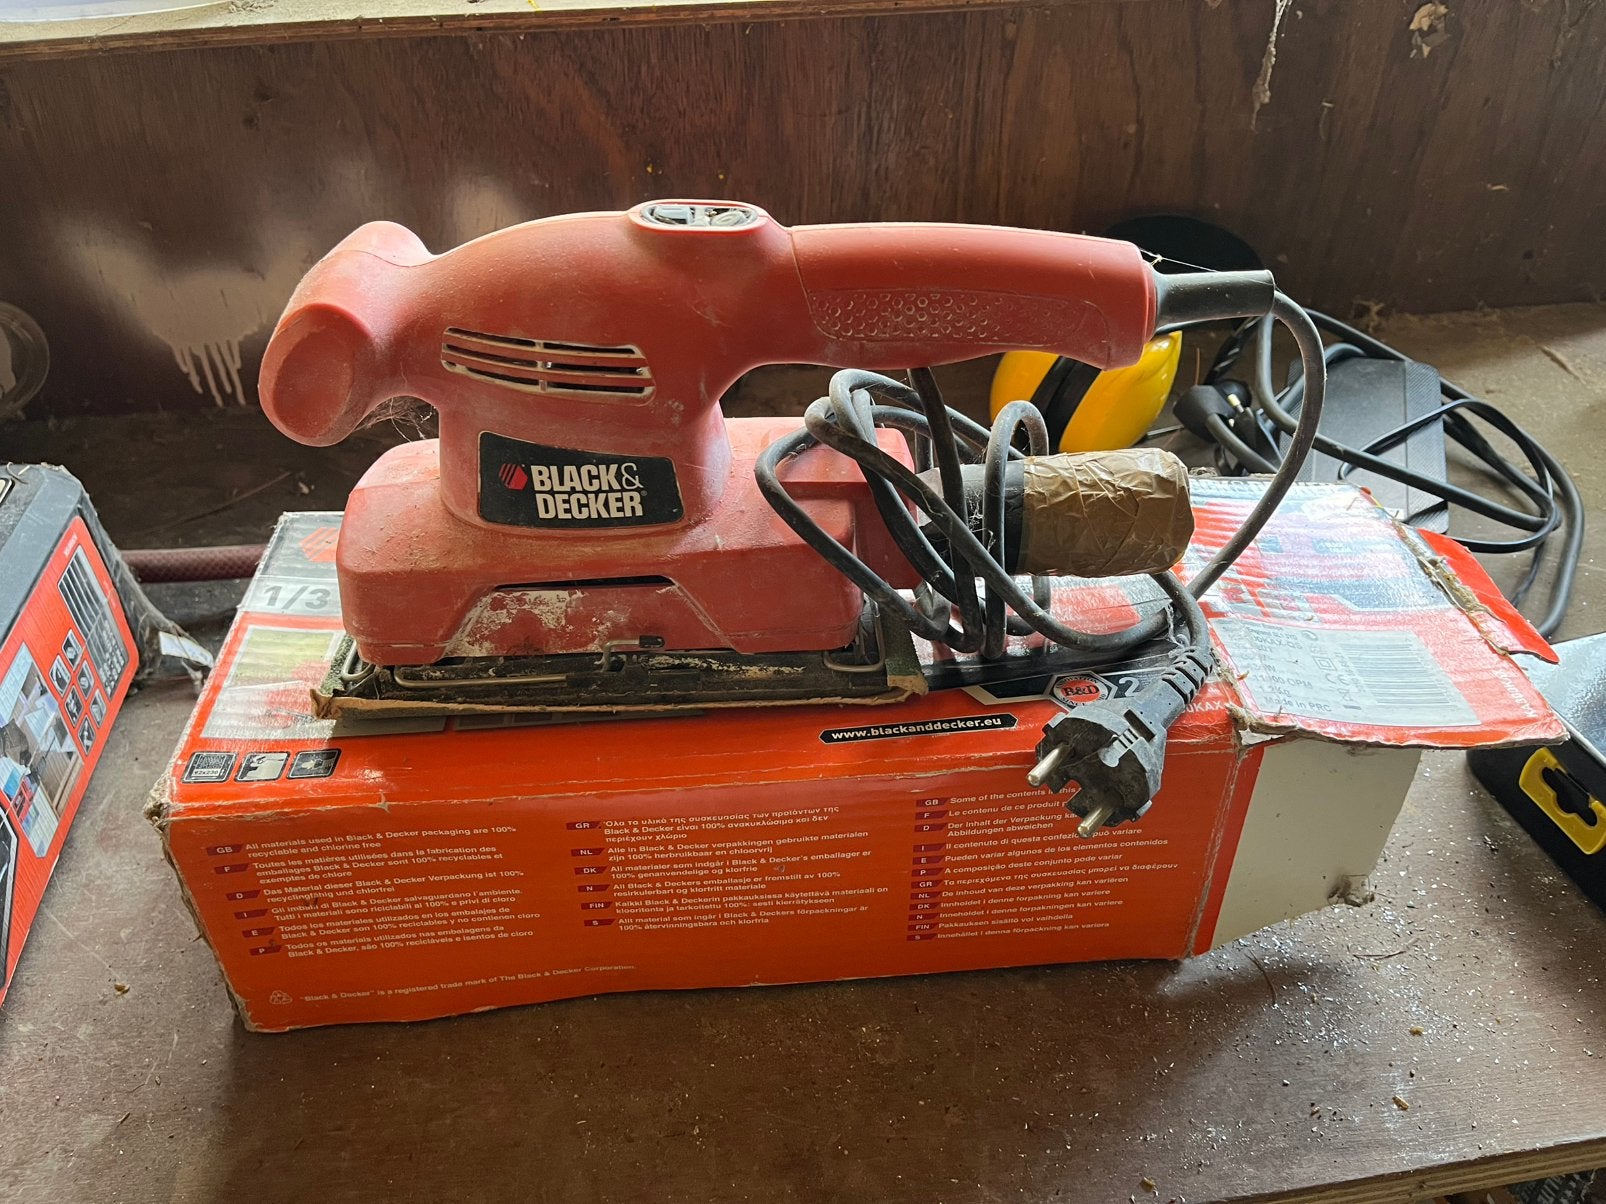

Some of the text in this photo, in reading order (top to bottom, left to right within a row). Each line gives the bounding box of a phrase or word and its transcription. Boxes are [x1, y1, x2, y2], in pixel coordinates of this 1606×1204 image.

[536, 491, 643, 519] DECKER
[264, 585, 331, 610] 1/3
[1062, 685, 1100, 697] B&D
[1118, 676, 1141, 698] 2
[1308, 702, 1332, 712] PRC
[831, 716, 1002, 740] www.blackanddecker.eu
